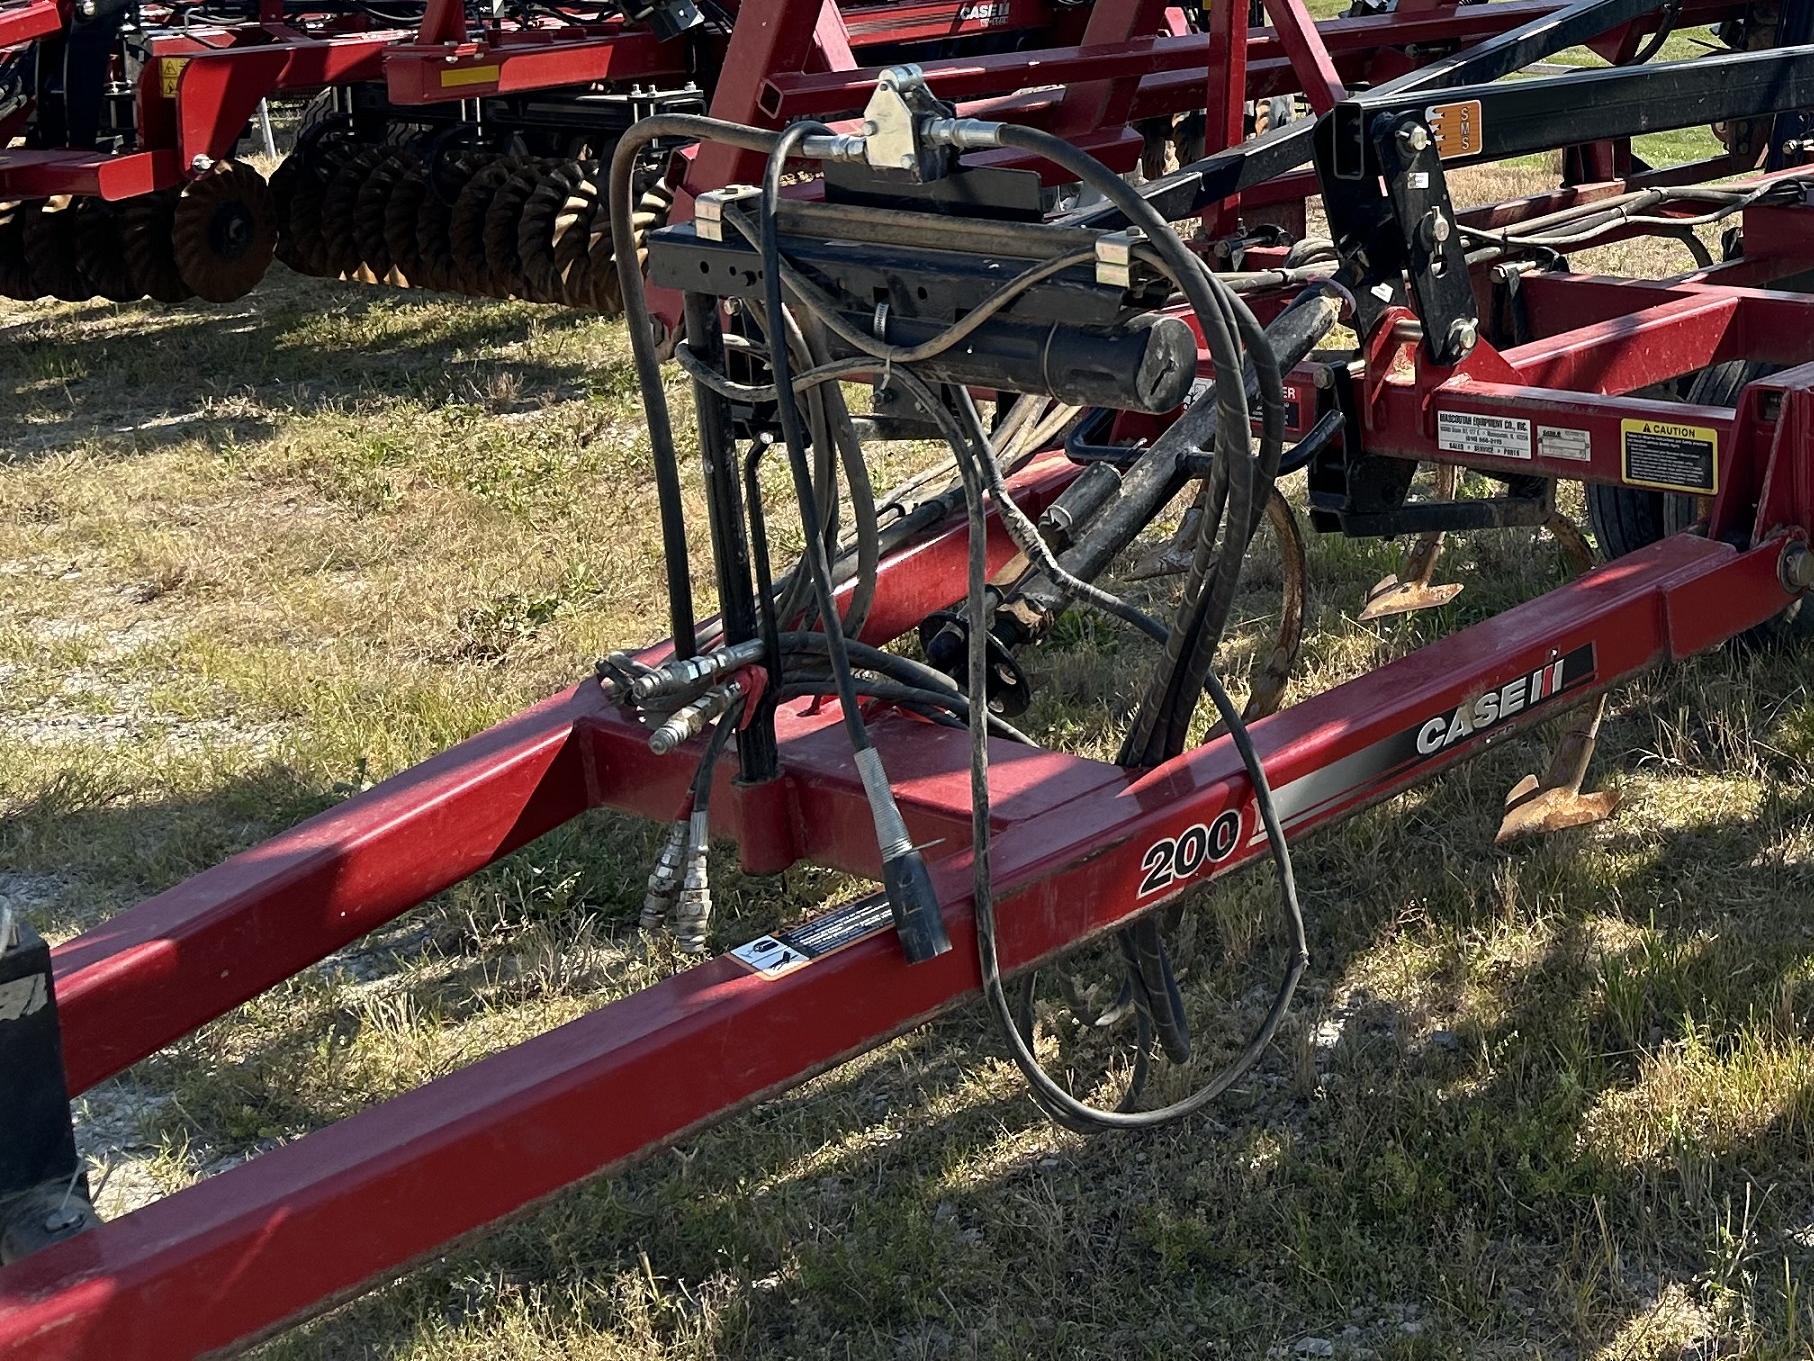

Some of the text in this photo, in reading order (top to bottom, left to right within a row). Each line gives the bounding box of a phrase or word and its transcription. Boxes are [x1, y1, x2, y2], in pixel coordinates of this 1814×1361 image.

[1653, 424, 1695, 438] CAUTION
[1416, 676, 1527, 755] CASE
[1136, 809, 1243, 900] 200
